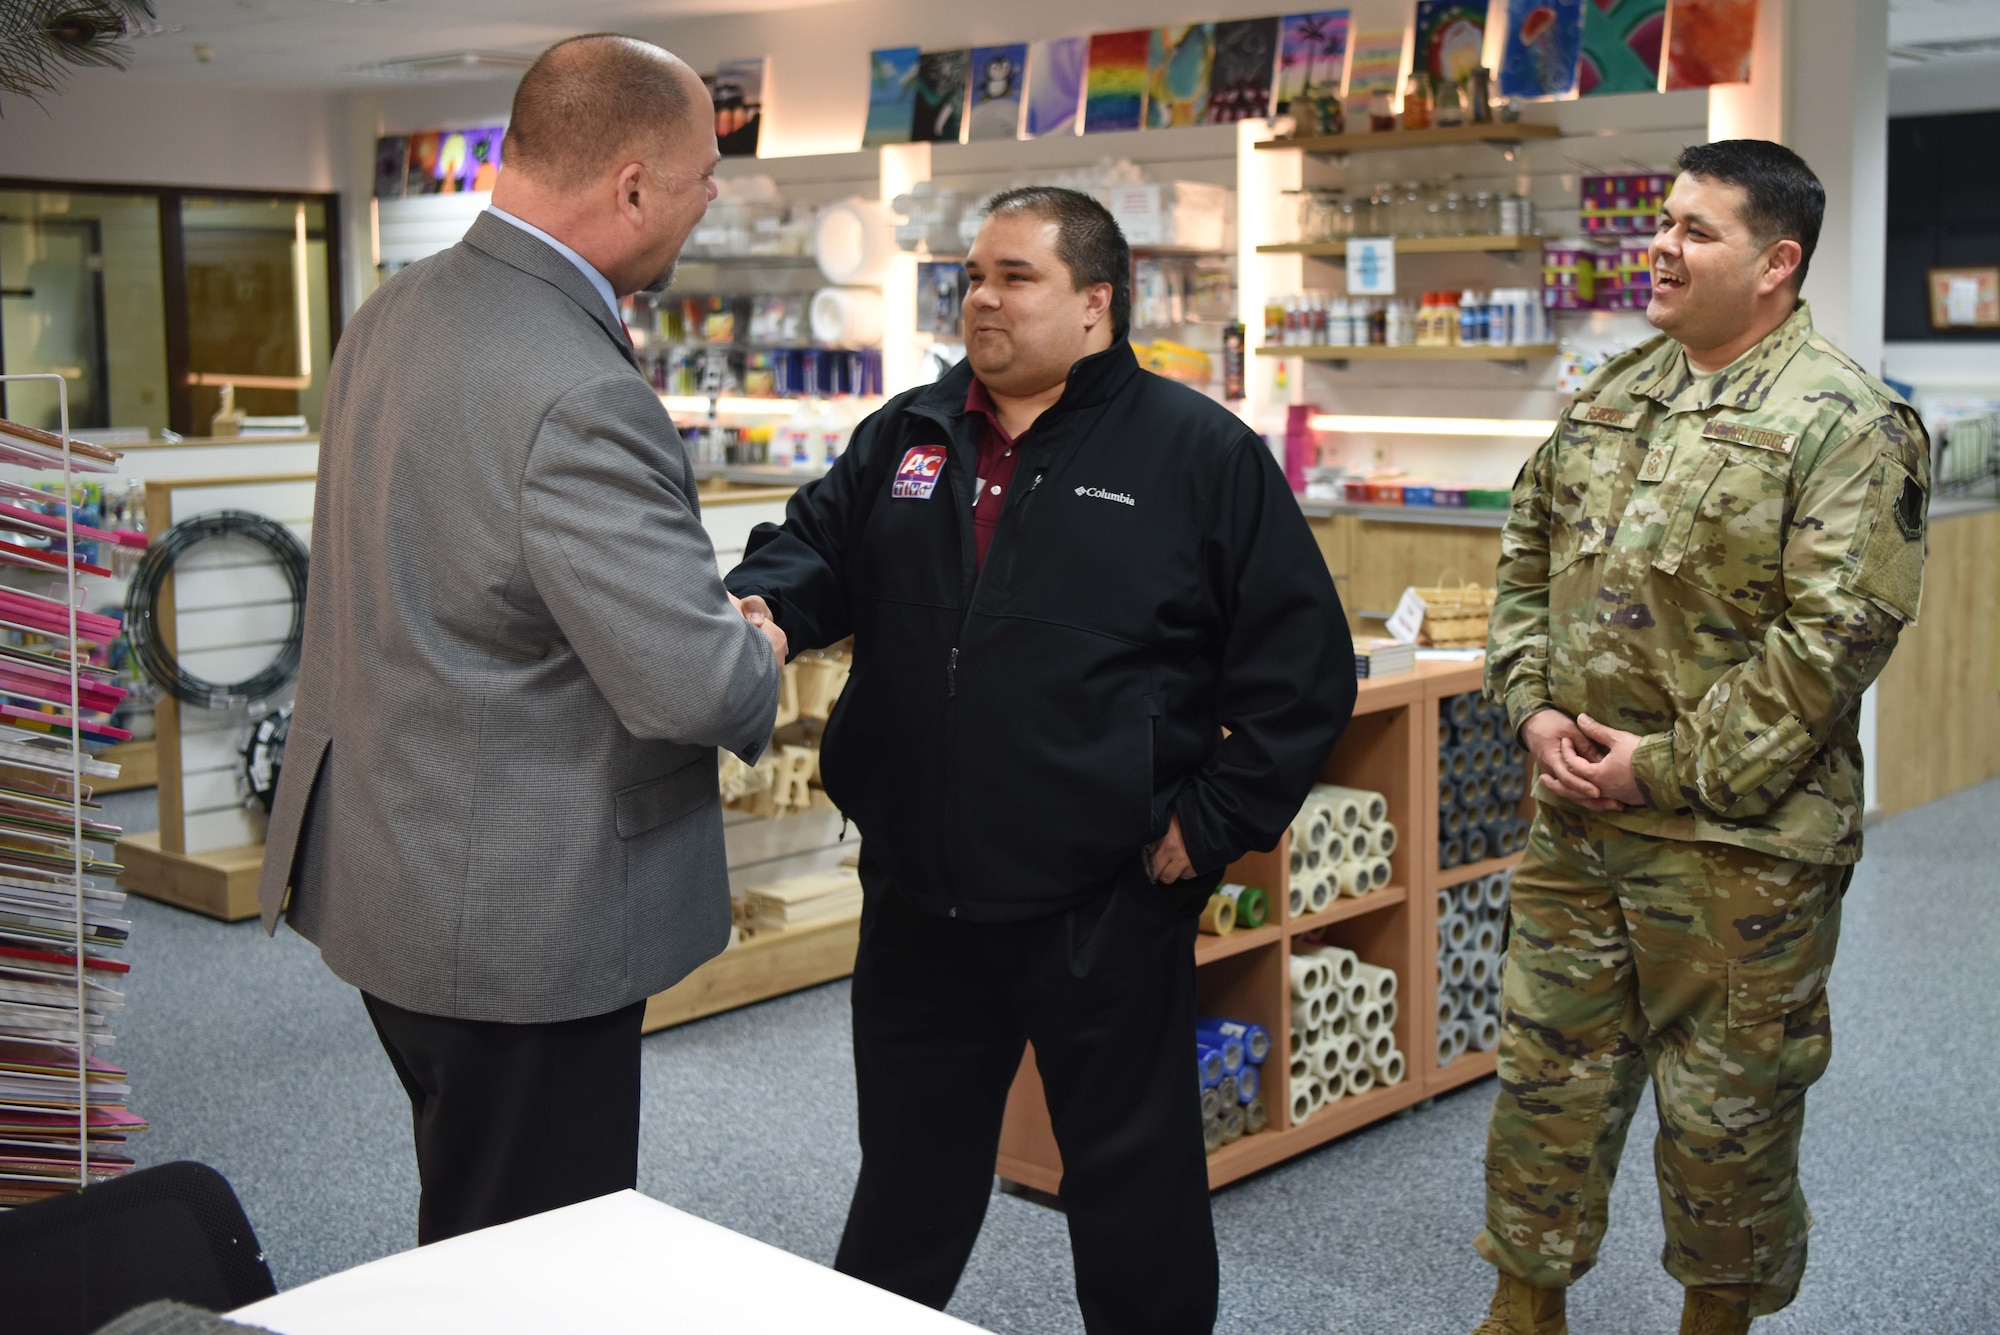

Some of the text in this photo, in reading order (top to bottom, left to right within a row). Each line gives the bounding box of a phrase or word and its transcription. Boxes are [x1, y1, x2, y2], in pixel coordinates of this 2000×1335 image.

[1725, 425, 1748, 441] AIR
[1748, 428, 1790, 450] FORCE
[900, 453, 942, 477] A&C
[1086, 487, 1135, 506] Columbia
